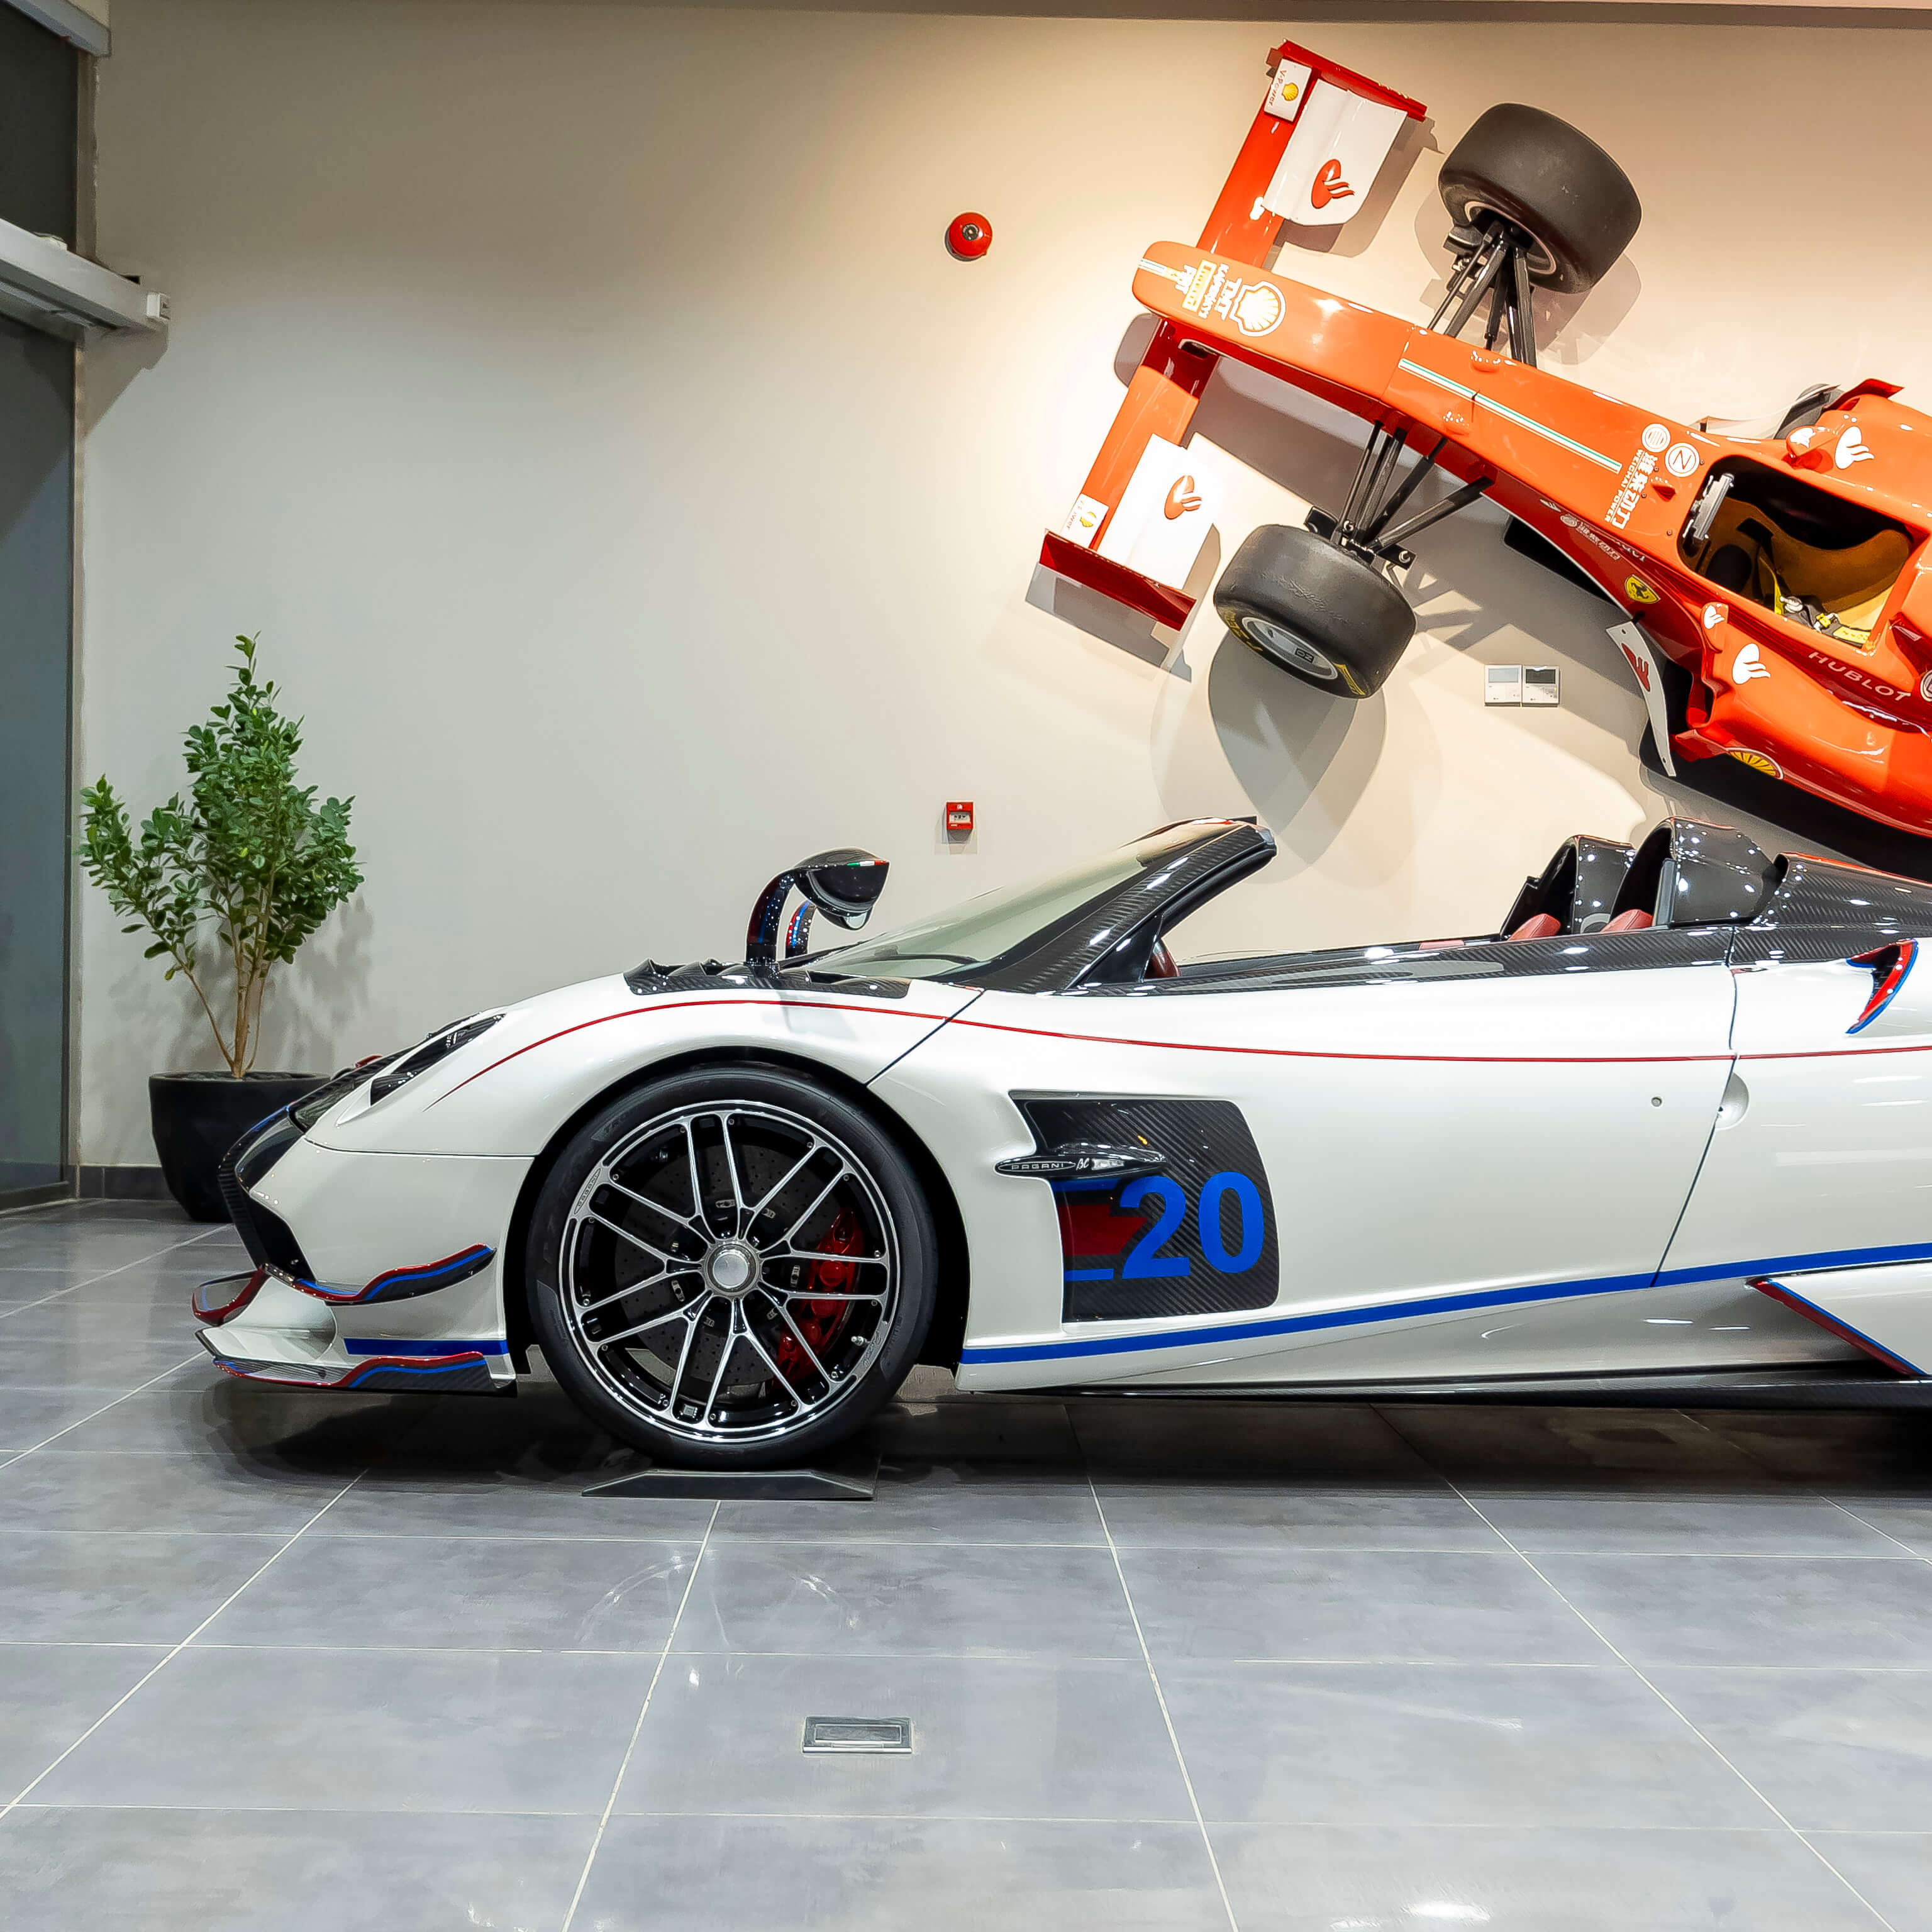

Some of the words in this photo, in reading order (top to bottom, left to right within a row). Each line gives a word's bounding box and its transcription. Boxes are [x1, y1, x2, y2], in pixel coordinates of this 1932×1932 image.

[1268, 70, 1287, 106] V-Power
[1620, 448, 1643, 488] WEICHAI
[1604, 489, 1623, 522] POWER
[1808, 651, 1911, 701] HUBLOT
[1011, 1163, 1065, 1171] PAGANI
[1119, 1171, 1265, 1279] 20
